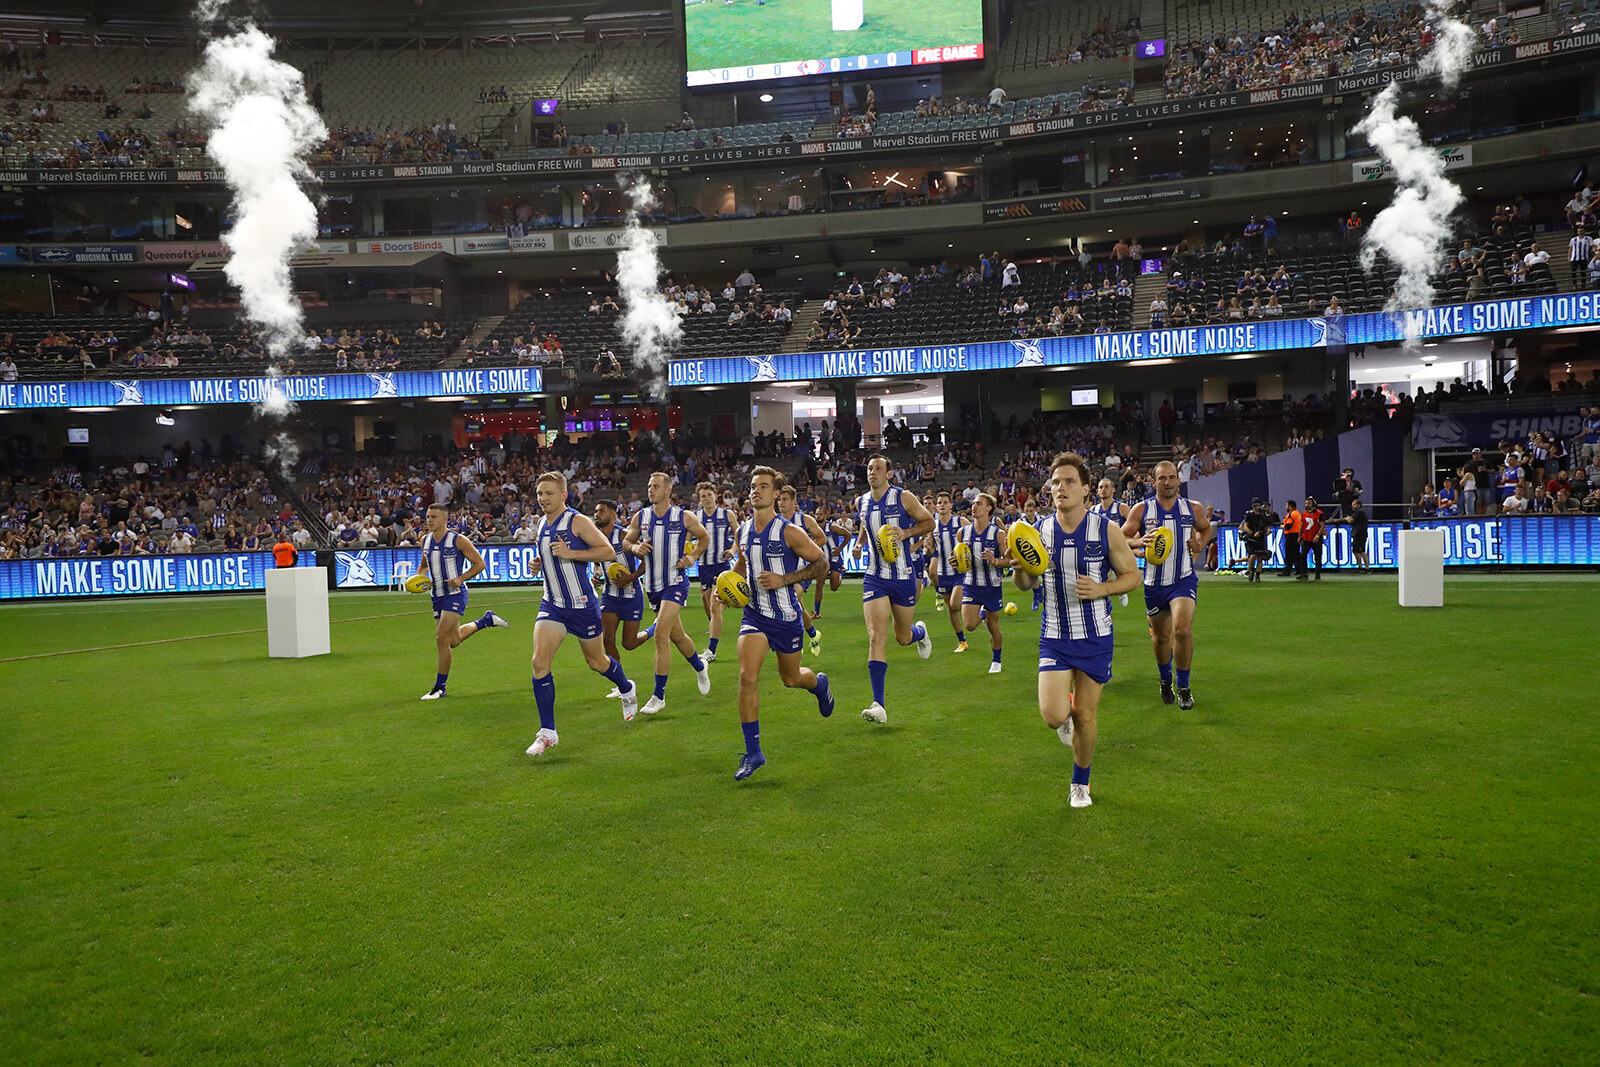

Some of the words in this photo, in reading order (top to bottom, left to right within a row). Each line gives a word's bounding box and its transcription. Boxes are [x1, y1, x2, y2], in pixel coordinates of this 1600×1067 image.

[917, 48, 941, 62] PRE
[943, 45, 978, 61] GAME
[1516, 41, 1550, 60] MARVEL
[1338, 75, 1378, 91] Marvel
[1475, 50, 1500, 66] Wifi
[1250, 90, 1280, 104] MARVEL
[1281, 84, 1324, 98] STADIUM
[1086, 112, 1118, 124] EPIC
[1136, 104, 1180, 118] LIVES
[1199, 96, 1237, 109] HERE
[1010, 122, 1036, 136] MARVEL
[1036, 118, 1074, 133] STADIUM
[801, 142, 826, 154] MARVEL
[826, 140, 862, 152] STADIUM
[873, 136, 906, 148] Marvel
[907, 133, 950, 146] Stadium
[952, 130, 978, 142] FREE
[979, 128, 999, 140] Wifi
[592, 158, 616, 168] MARVEL
[616, 156, 650, 166] STADIUM
[661, 154, 690, 164] EPIC
[704, 150, 743, 161] LIVES
[758, 146, 791, 157] HERE
[352, 169, 384, 178] HERE
[394, 166, 418, 177] MARVEL
[418, 165, 452, 176] STADIUM
[463, 163, 494, 173] Marvel
[496, 161, 536, 172] Stadium
[537, 160, 562, 170] FREE
[563, 159, 582, 169] Wifi
[40, 172, 73, 182] Marvel
[75, 171, 118, 182] Stadium
[120, 172, 146, 181] FREE
[148, 171, 167, 180] Wifi
[177, 170, 203, 181] MARVEL
[384, 241, 443, 252] DoorsBlinds
[584, 235, 596, 244] tlc
[76, 253, 110, 262] ORIGINAL
[112, 252, 134, 262] FLAKE
[1406, 306, 1464, 337] MAKE
[1473, 300, 1531, 331] SOME
[1095, 334, 1142, 360] MAKE
[1150, 330, 1197, 356] SOME
[1206, 326, 1255, 351] NOISE
[823, 352, 866, 376] MAKE
[873, 349, 915, 374] SOME
[922, 347, 966, 370] NOISE
[190, 380, 234, 402] MAKE
[286, 377, 327, 398] NOISE
[442, 372, 486, 394] MAKE
[489, 369, 530, 392] SOME
[22, 384, 68, 404] NOISE
[1414, 522, 1502, 560] OISE
[37, 561, 103, 595] MAKE
[112, 558, 176, 591] SOME
[186, 556, 250, 588] NOISE
